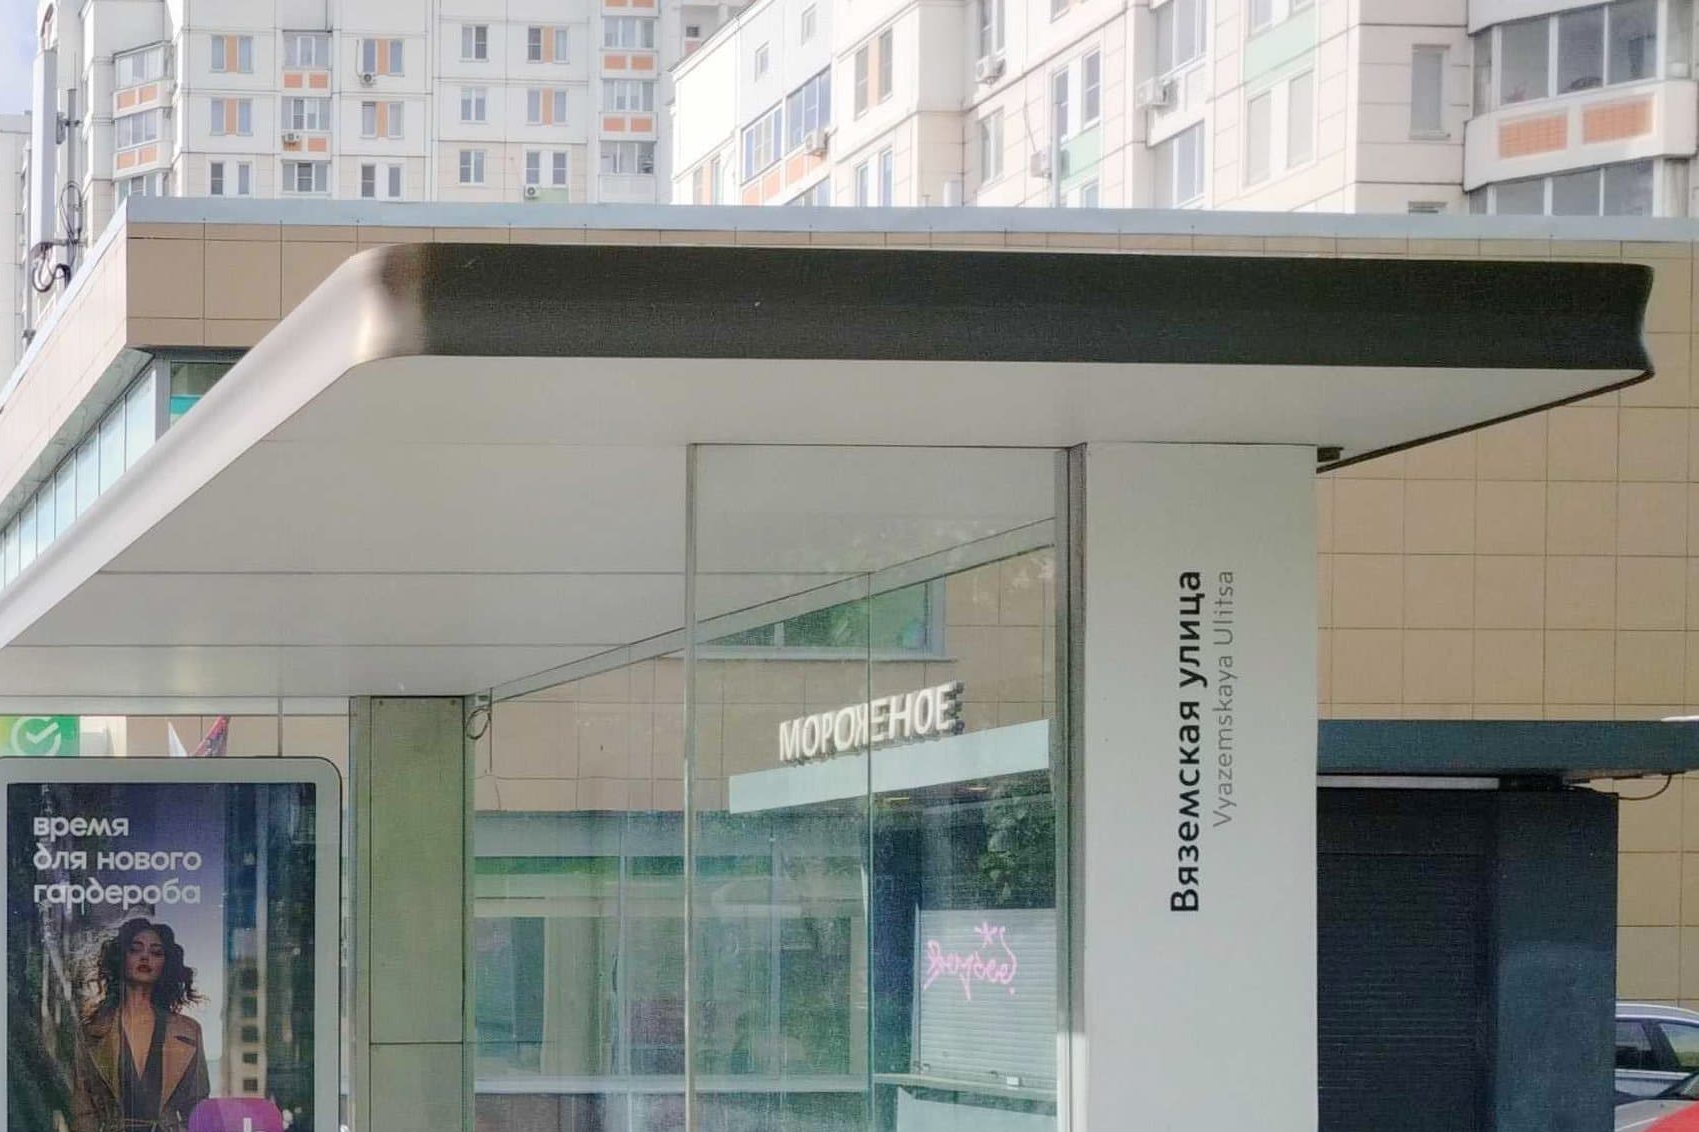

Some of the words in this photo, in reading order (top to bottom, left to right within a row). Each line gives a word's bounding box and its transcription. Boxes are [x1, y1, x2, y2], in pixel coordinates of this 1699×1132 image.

[1179, 571, 1208, 688] улица
[1213, 571, 1234, 645] Ulitsa
[1212, 655, 1238, 827] Vyazemskaya
[33, 816, 129, 842] время
[1170, 701, 1201, 912] Вяземская
[33, 843, 87, 870] для
[97, 851, 202, 871] нового
[34, 877, 201, 910] гардероба
